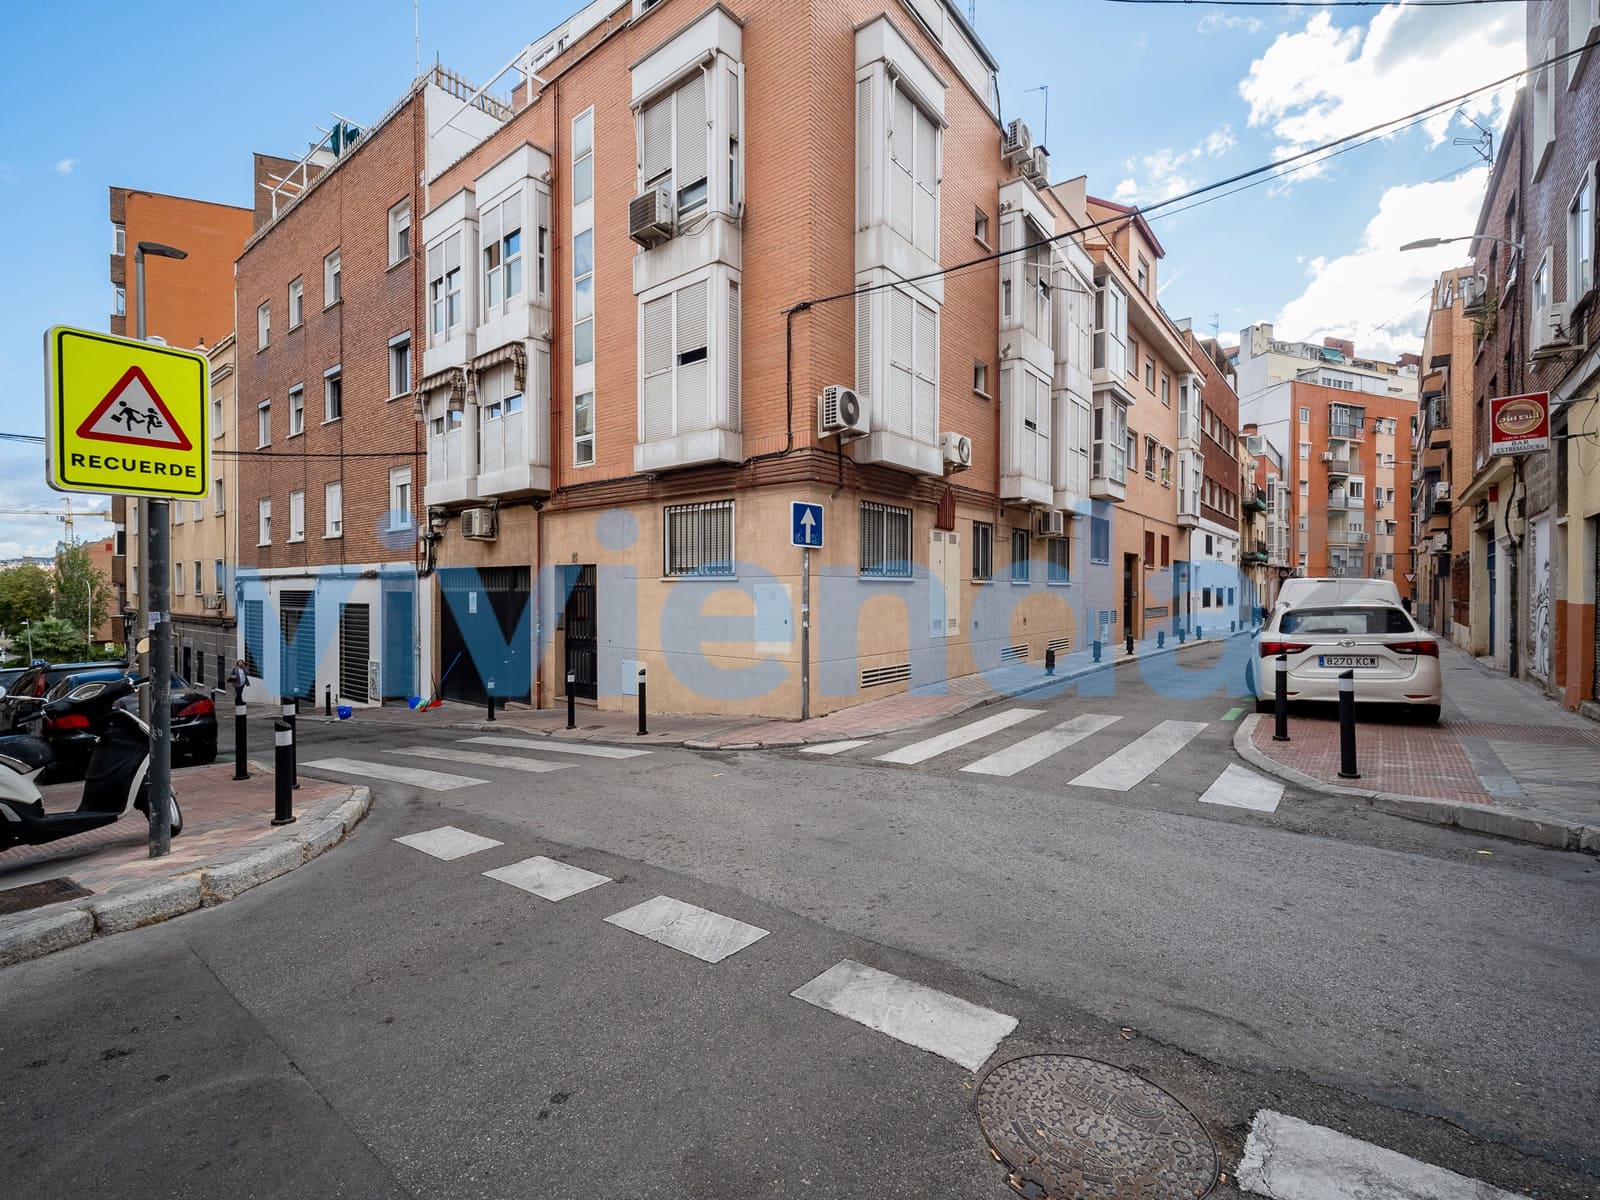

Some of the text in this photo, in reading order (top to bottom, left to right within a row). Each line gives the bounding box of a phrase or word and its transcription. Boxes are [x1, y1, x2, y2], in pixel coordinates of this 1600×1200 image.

[1496, 444, 1544, 453] EXTREMADURA
[71, 453, 196, 478] RECUERDE
[1326, 657, 1377, 666] 8270 KCW
[1065, 1074, 1116, 1105] Canal
